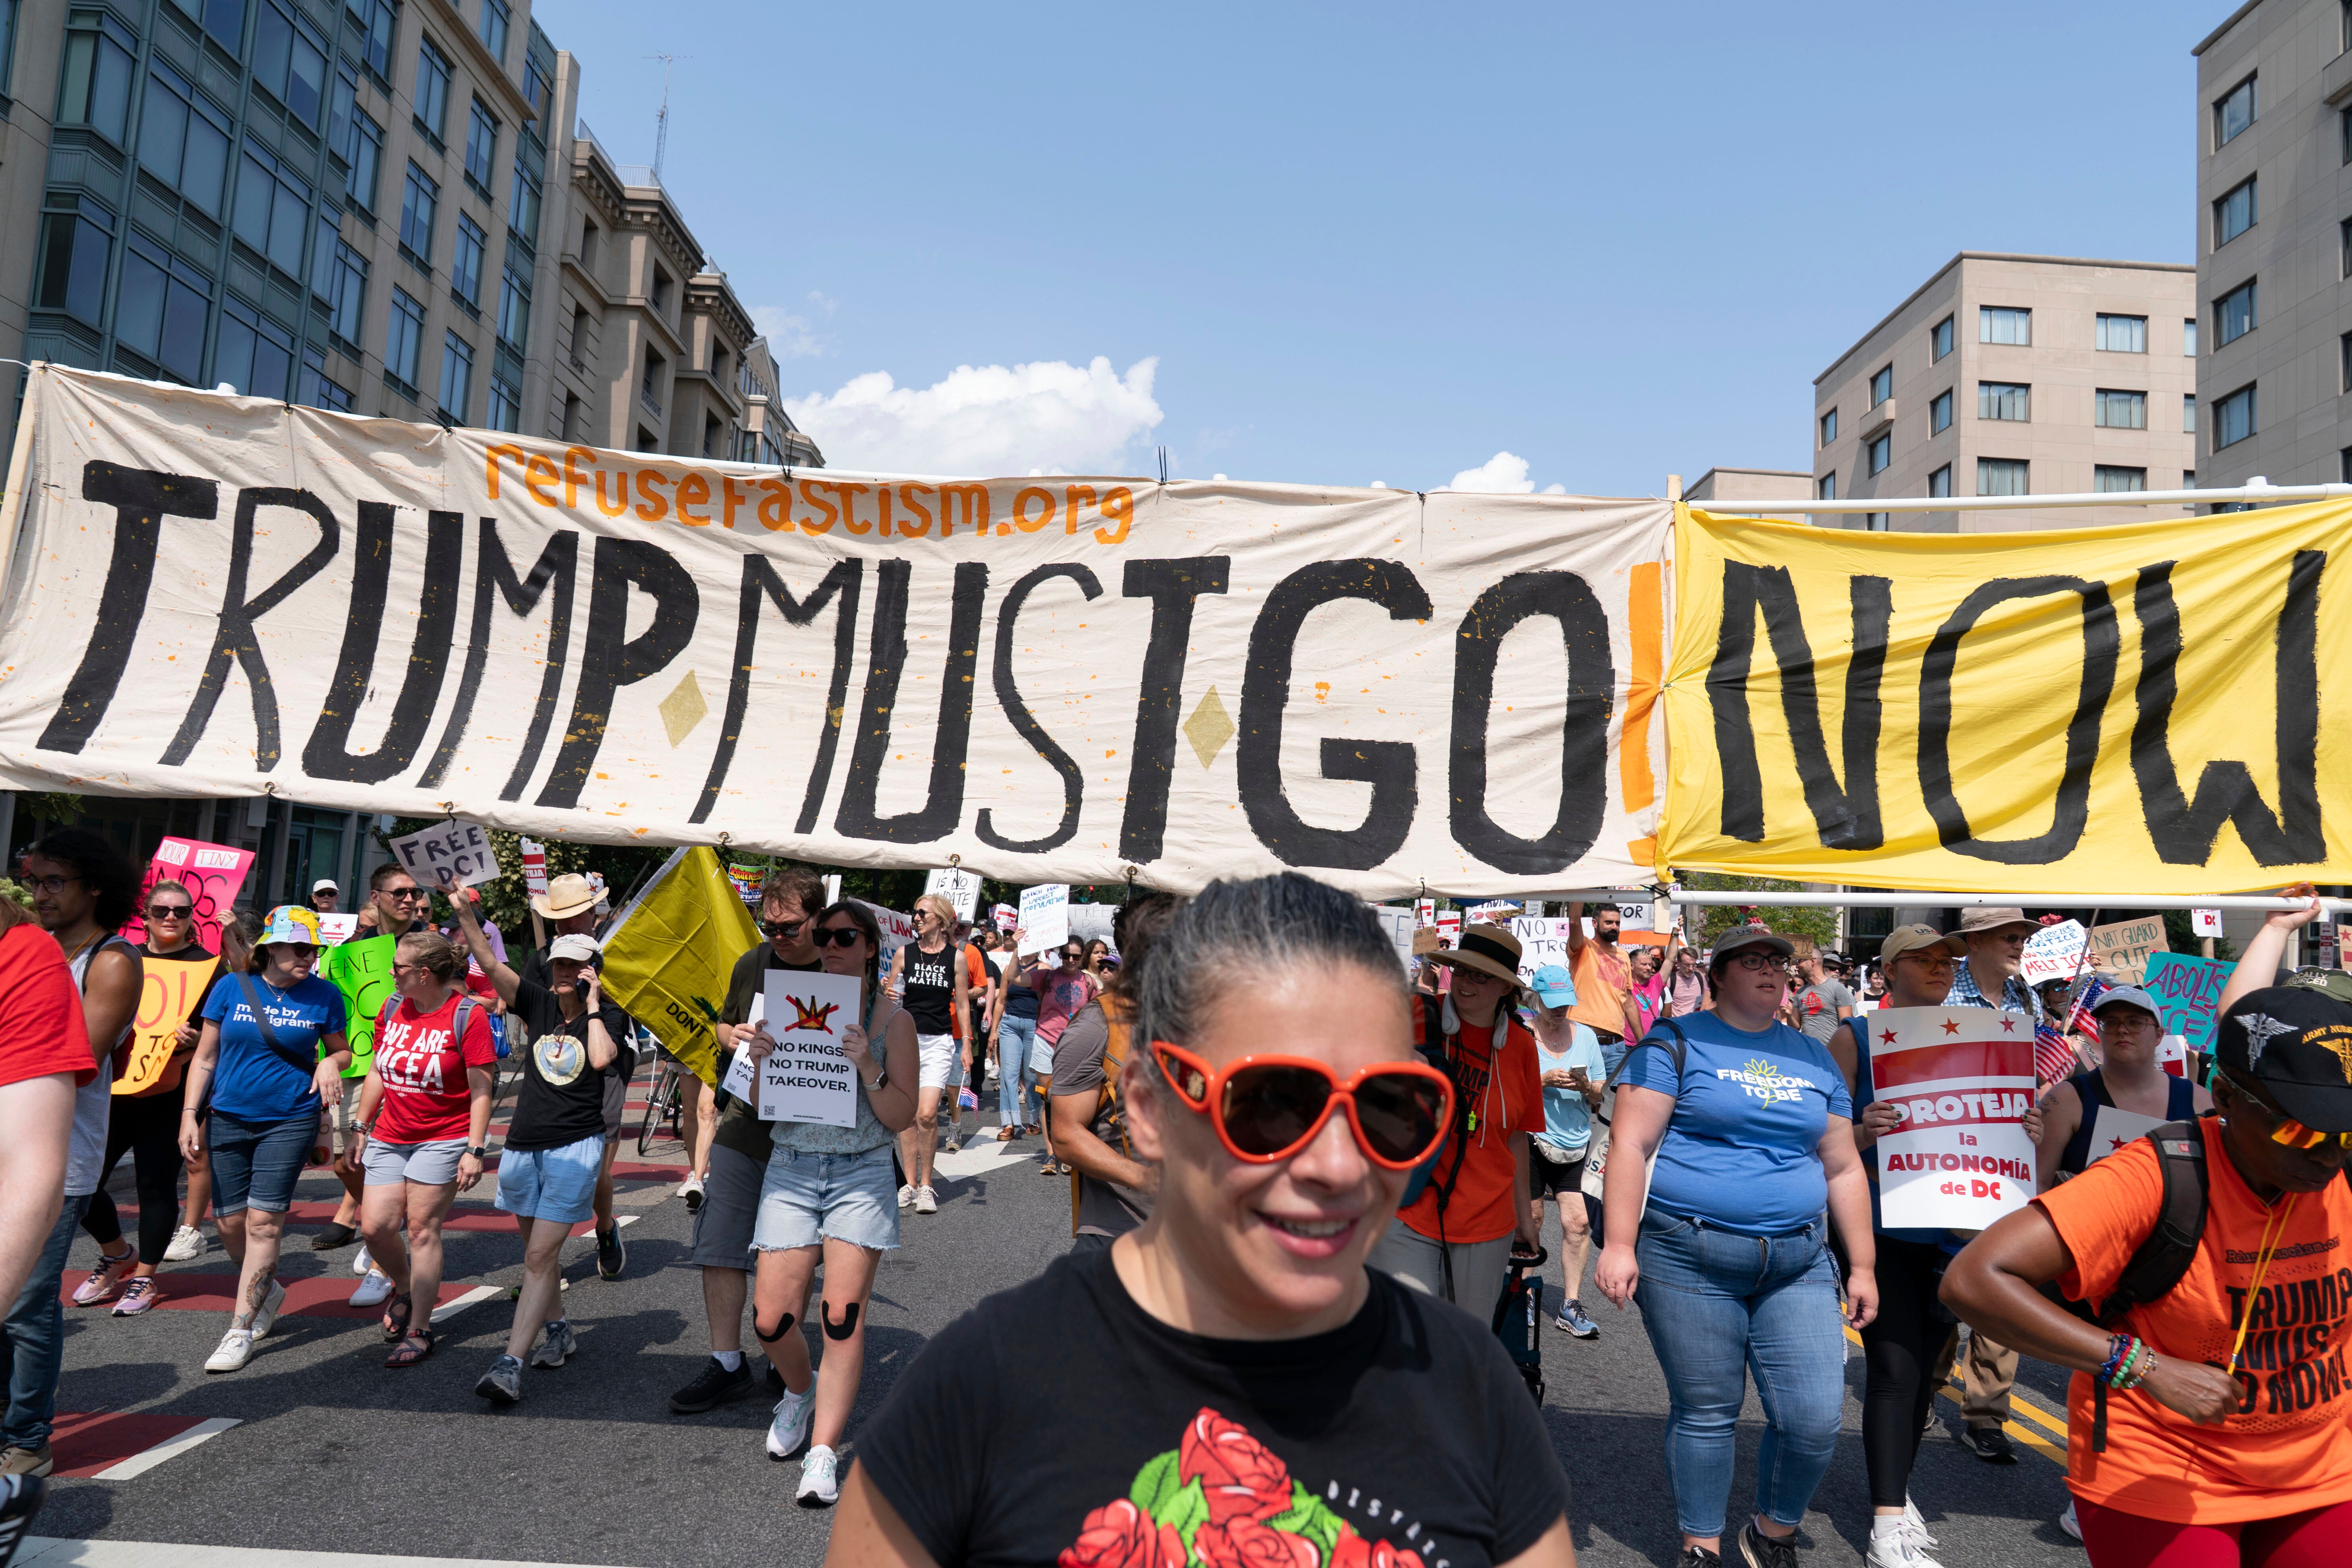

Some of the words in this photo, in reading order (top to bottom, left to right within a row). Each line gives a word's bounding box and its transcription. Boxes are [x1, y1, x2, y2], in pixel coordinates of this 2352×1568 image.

[36, 459, 699, 809] TRUMP
[688, 554, 1231, 862] MUST
[1705, 550, 2327, 868] NOW
[399, 826, 482, 866] FREE
[161, 844, 186, 864] YOUR
[200, 851, 237, 867] TINY
[436, 851, 484, 884] DC!
[936, 877, 947, 888] IS
[951, 876, 967, 888] NO
[1023, 890, 1042, 900] WHICH
[1029, 891, 1055, 904] LARGEST
[1075, 906, 1110, 918] FREE
[878, 916, 887, 925] OF
[889, 915, 913, 939] LAW
[1082, 919, 1100, 928] DC
[1517, 919, 1546, 938] NO
[880, 933, 890, 943] OT
[2094, 930, 2119, 950] NAT
[2121, 923, 2158, 945] GUARD
[1529, 940, 1567, 954] TRO
[1802, 940, 1813, 954] DC
[2056, 941, 2087, 955] WHIST
[328, 951, 378, 980] EAVE
[2111, 946, 2148, 969] OUT
[914, 963, 946, 973] BLACK
[916, 970, 943, 979] LIVES
[2025, 960, 2059, 976] MELT
[908, 976, 948, 988] MATTER
[2145, 962, 2229, 1017] ABOLIS
[236, 1004, 279, 1014] mde
[282, 1007, 300, 1018] by
[666, 1002, 708, 1038] DONT
[383, 1020, 412, 1049] WE
[411, 1028, 451, 1054] ARE
[2302, 1027, 2327, 1044] ARMY
[773, 1042, 795, 1052] NO
[376, 1043, 444, 1089] MCEA
[769, 1059, 792, 1069] NO
[795, 1060, 849, 1074] TRUMP
[766, 1076, 850, 1092] TAKEOVER.
[1717, 1069, 1815, 1088] FREEDOM
[1741, 1084, 1770, 1099] TO
[1775, 1089, 1803, 1101] BE
[1959, 1132, 1977, 1146] la
[1887, 1153, 2031, 1182] AUTONOMÍA
[1940, 1181, 1966, 1195] de
[1971, 1179, 2001, 1200] DC
[2226, 1267, 2352, 1330] TRUMP
[2267, 1341, 2352, 1414] NOW!
